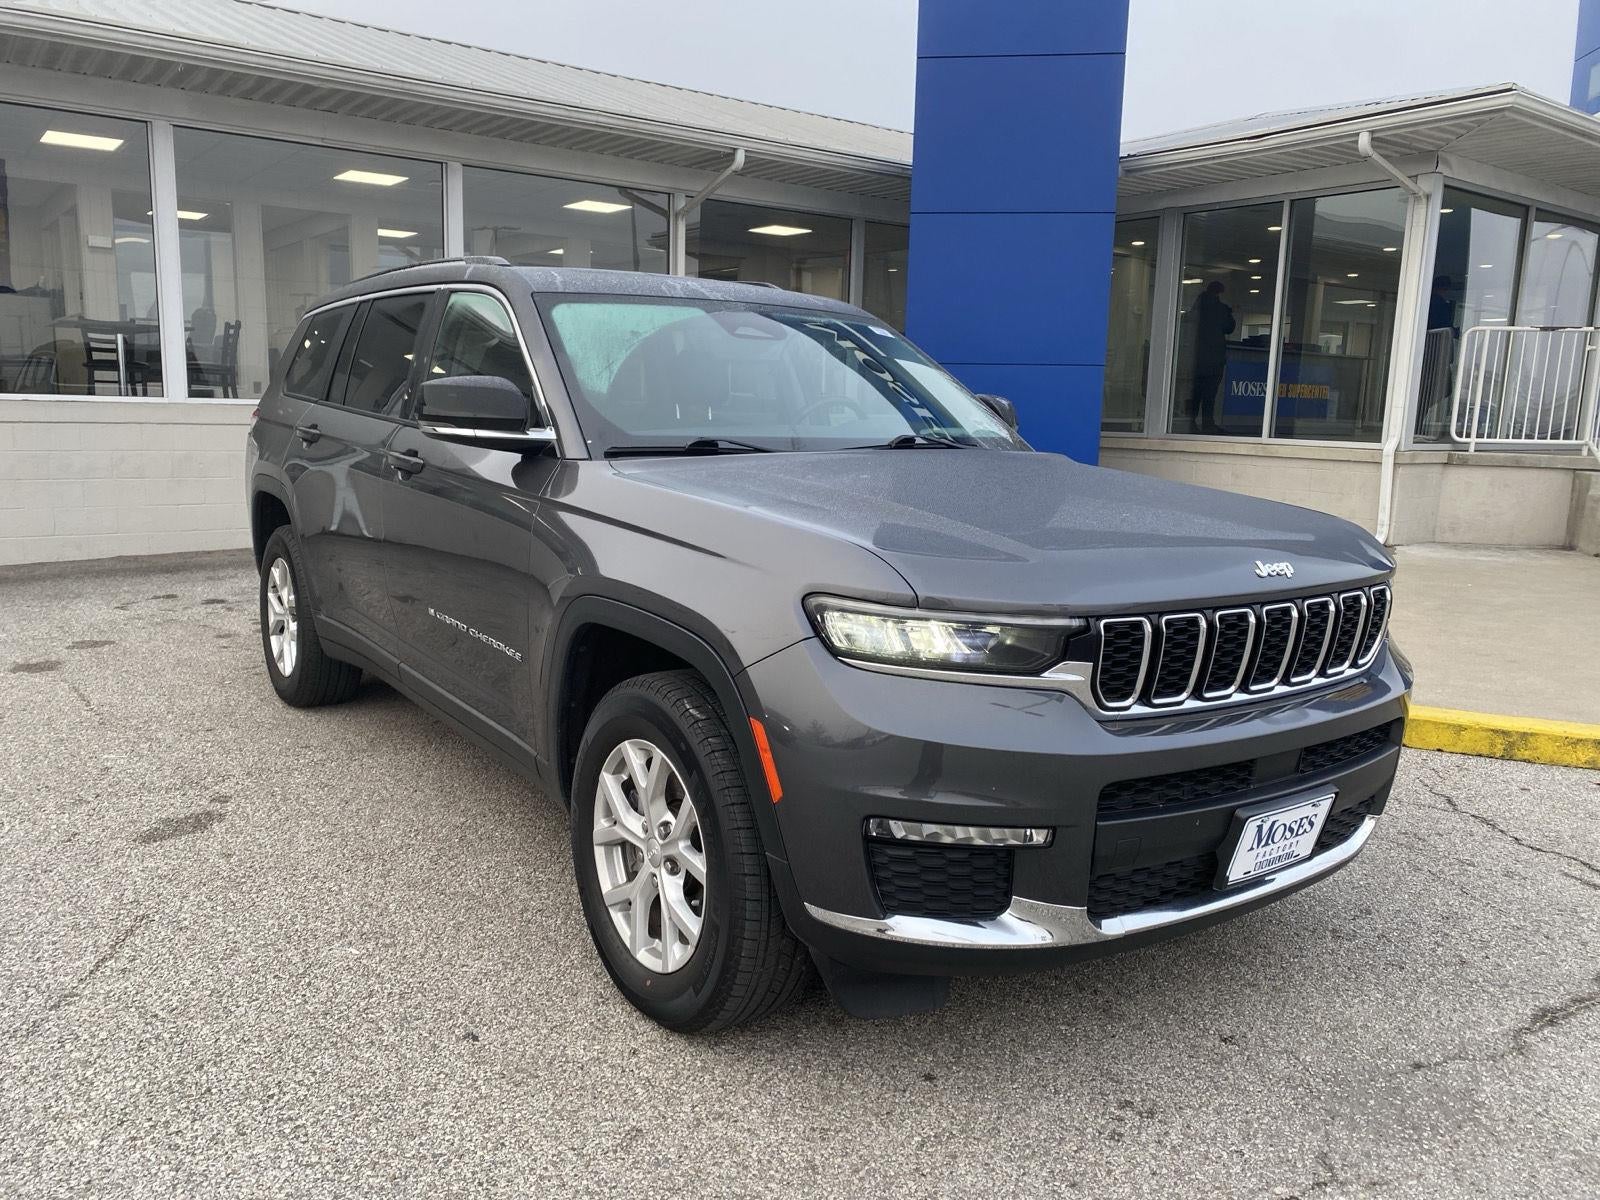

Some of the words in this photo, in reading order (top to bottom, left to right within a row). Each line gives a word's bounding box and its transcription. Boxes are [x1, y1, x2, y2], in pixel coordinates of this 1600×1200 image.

[1254, 560, 1295, 579] Jeep
[436, 611, 467, 632] GRAND
[468, 628, 523, 662] CHEROKEE
[1247, 813, 1318, 852] MOSES
